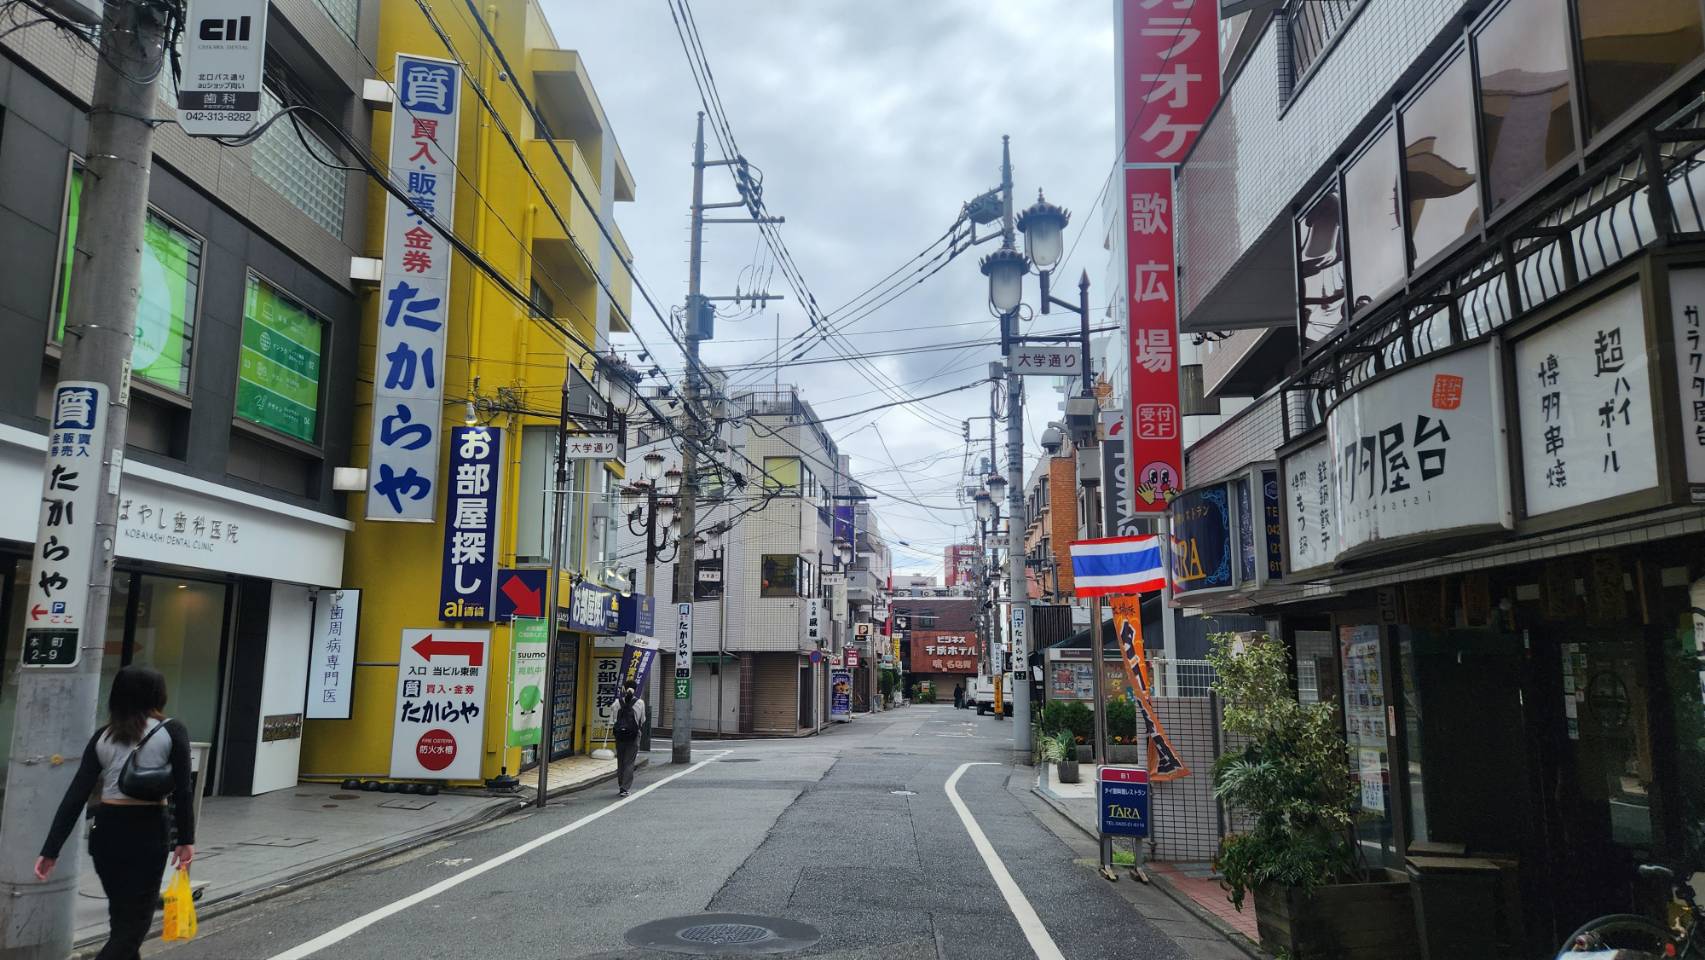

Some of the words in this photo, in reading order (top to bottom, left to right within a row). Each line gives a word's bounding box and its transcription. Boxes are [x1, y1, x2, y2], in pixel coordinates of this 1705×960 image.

[198, 73, 245, 81] 北口バス通り
[1139, 0, 1203, 159] ラオケ
[406, 66, 451, 112] 質
[203, 92, 236, 105] 歯科
[185, 111, 252, 122] 042-313-8282
[1131, 192, 1173, 374] 歌広場
[1018, 352, 1077, 368] 大学通り
[374, 280, 444, 514] たからや
[56, 390, 93, 427] 質
[1140, 406, 1173, 423] 受付
[1538, 353, 1569, 490] 博多串焼
[1142, 424, 1173, 437] 2F
[571, 442, 614, 454] 大学通り
[1338, 414, 1451, 504] クタ屋台
[451, 430, 492, 595] お部屋探し
[39, 463, 80, 598] たからや
[166, 535, 191, 549] DENTAL
[192, 540, 215, 553] CLINIC
[54, 603, 63, 613] P
[444, 598, 465, 617] ai
[50, 616, 73, 624] ここ
[30, 637, 64, 648] 本町
[679, 621, 688, 659] たからや
[31, 650, 57, 661] 2-9
[322, 604, 344, 703] 歯周病専門医
[408, 666, 427, 676] 入口
[432, 667, 479, 677] 当ビル東側
[405, 681, 420, 697] 質
[426, 684, 475, 695] 買入・金券
[596, 659, 618, 719] お部屋探し
[677, 684, 687, 696] 文
[401, 700, 480, 724] たからや
[419, 745, 454, 755] 防火水槽
[1107, 804, 1142, 820] TARA
